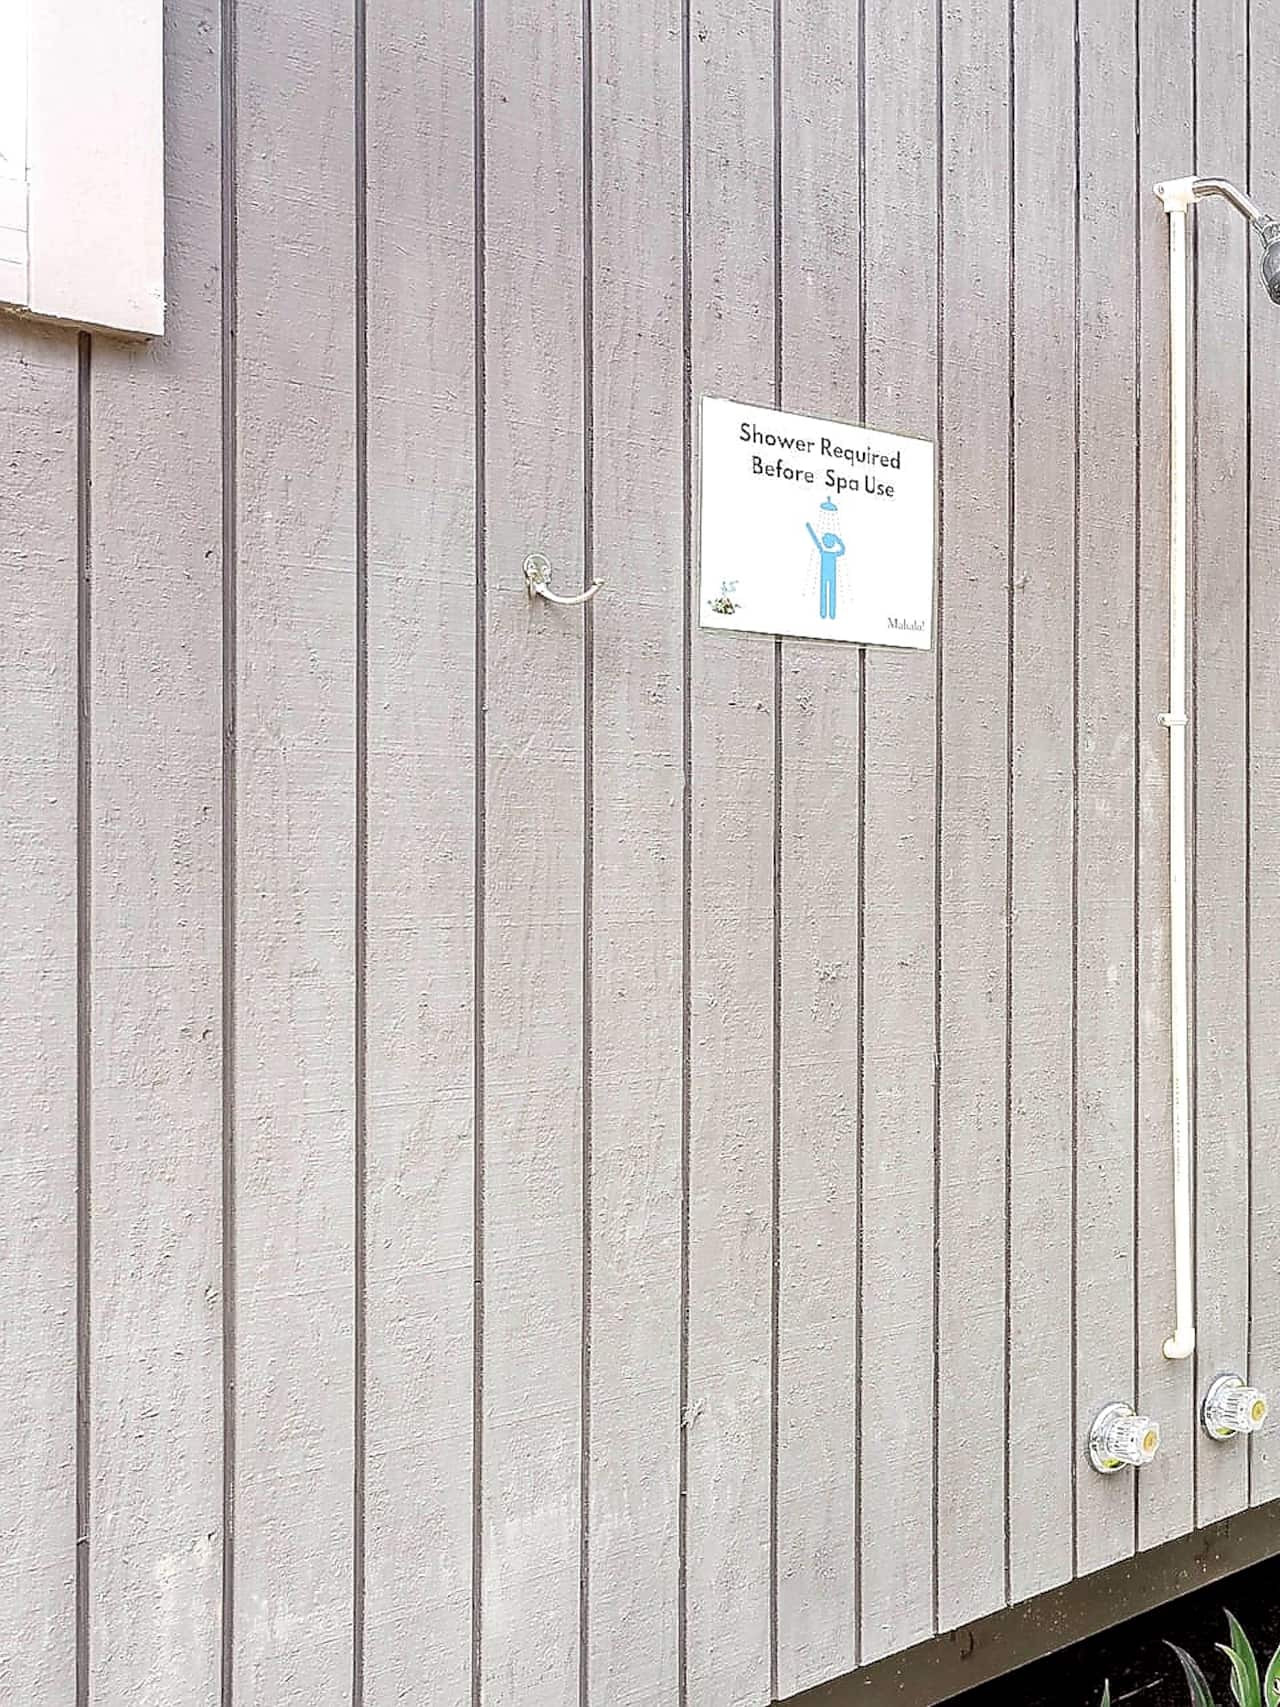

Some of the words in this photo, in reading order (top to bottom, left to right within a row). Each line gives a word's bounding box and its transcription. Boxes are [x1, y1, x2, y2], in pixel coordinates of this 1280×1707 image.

[739, 422, 815, 453] Shower
[820, 437, 901, 469] Required
[752, 455, 814, 483] Before
[825, 469, 859, 494] Spa
[865, 475, 895, 498] Use
